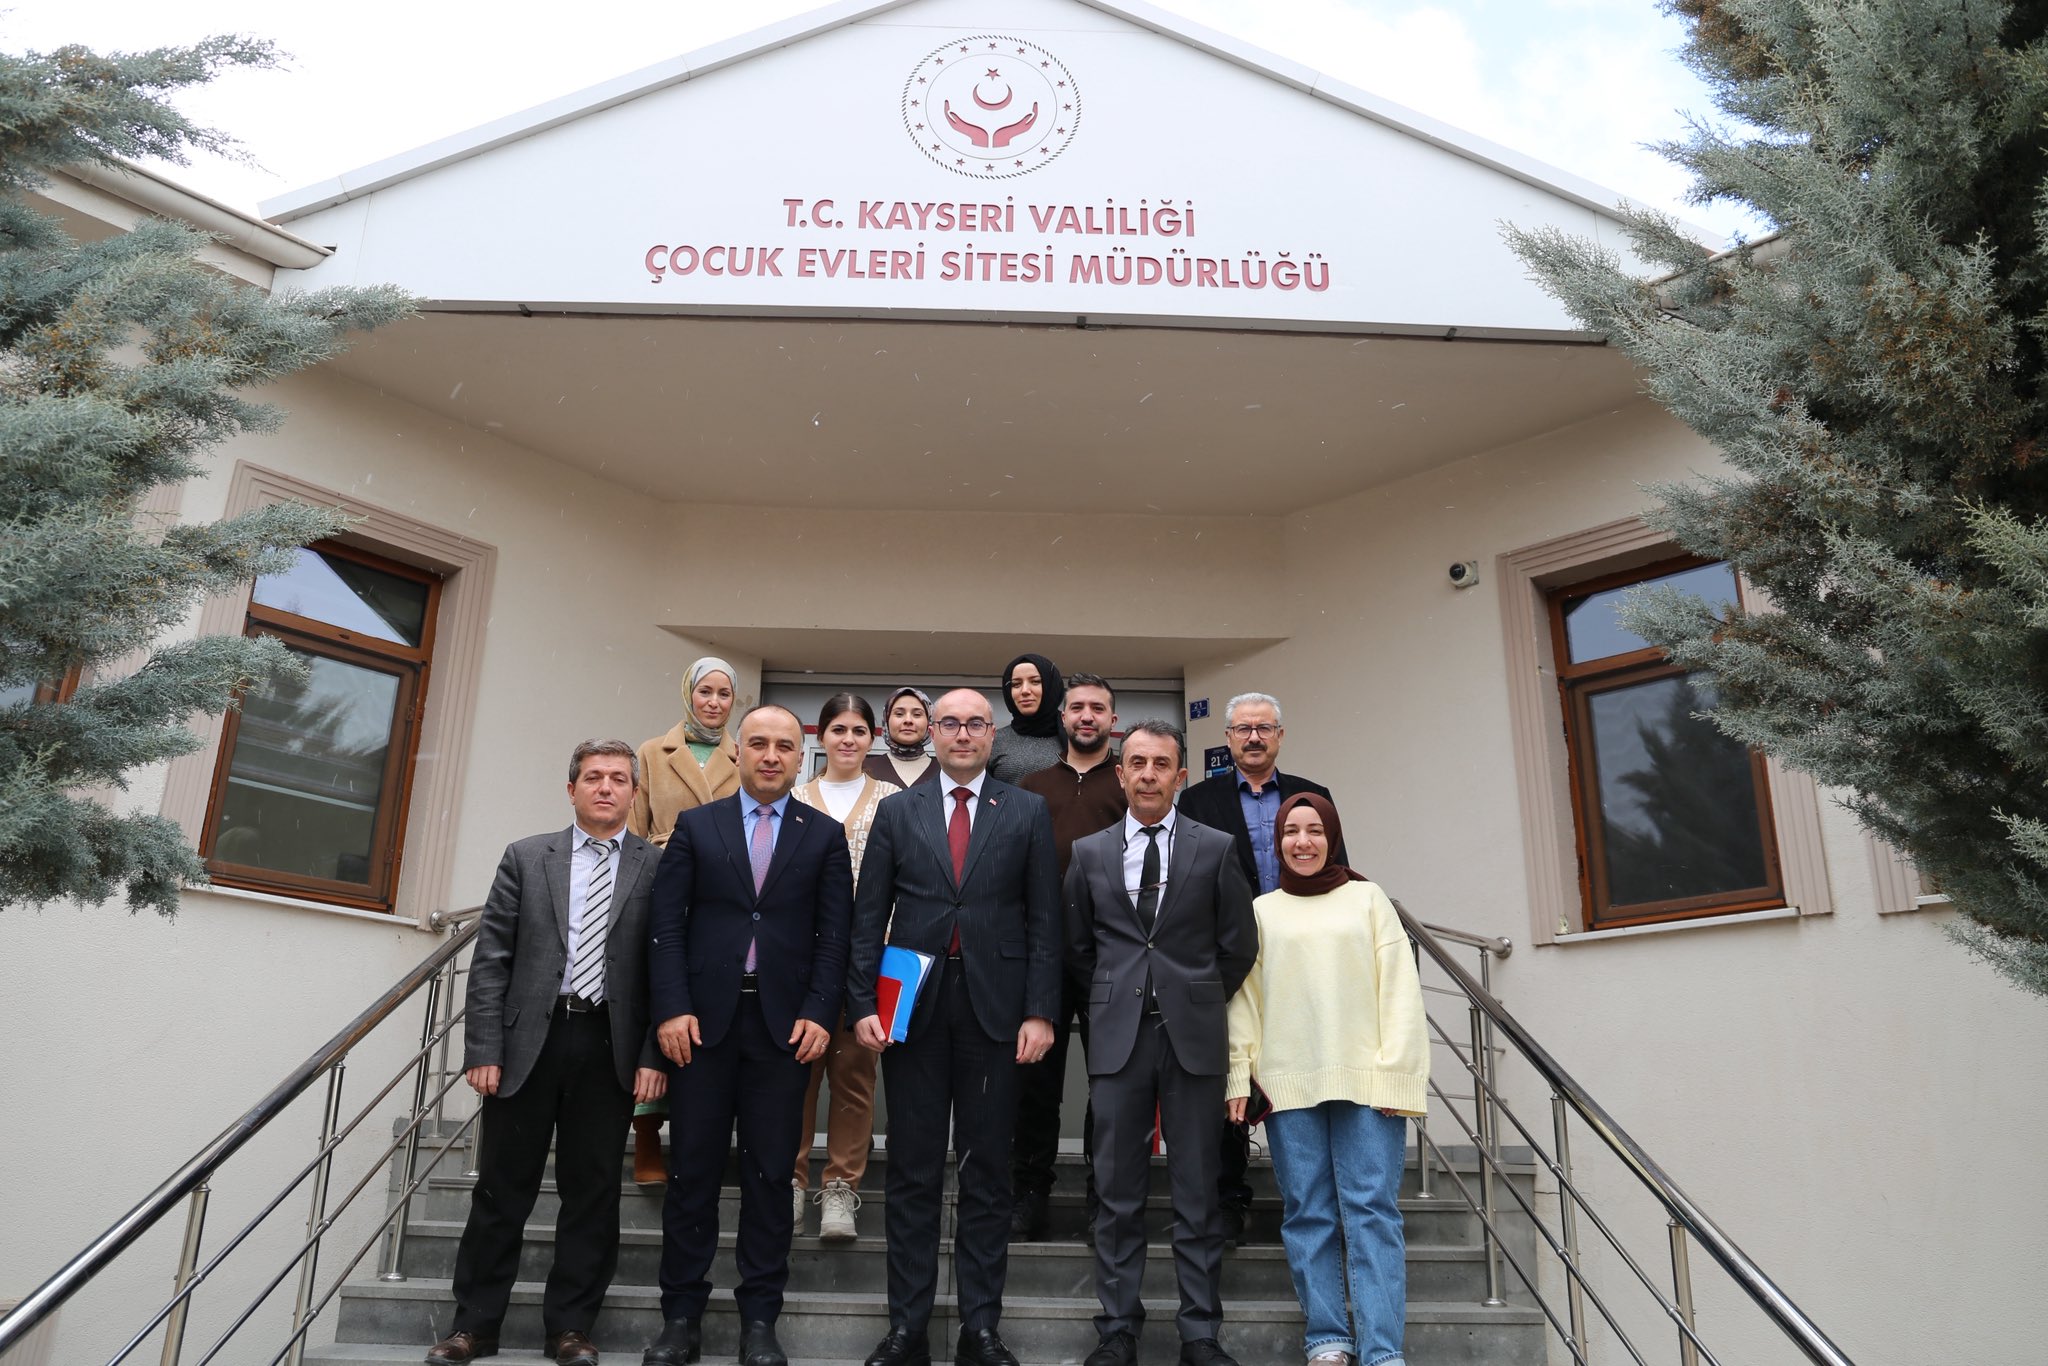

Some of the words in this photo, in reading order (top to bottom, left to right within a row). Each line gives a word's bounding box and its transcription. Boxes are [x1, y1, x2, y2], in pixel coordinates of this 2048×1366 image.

[783, 198, 844, 229] T.C.
[858, 195, 1015, 233] KAYSERİ
[1028, 198, 1195, 238] VALİLİĞİ
[645, 244, 784, 284] ÇOCUK
[798, 242, 925, 281] EVLERİ
[940, 243, 1054, 283] SİTESİ
[1069, 247, 1330, 293] MÜDÜRLÜĞÜ
[1211, 756, 1221, 767] 21
